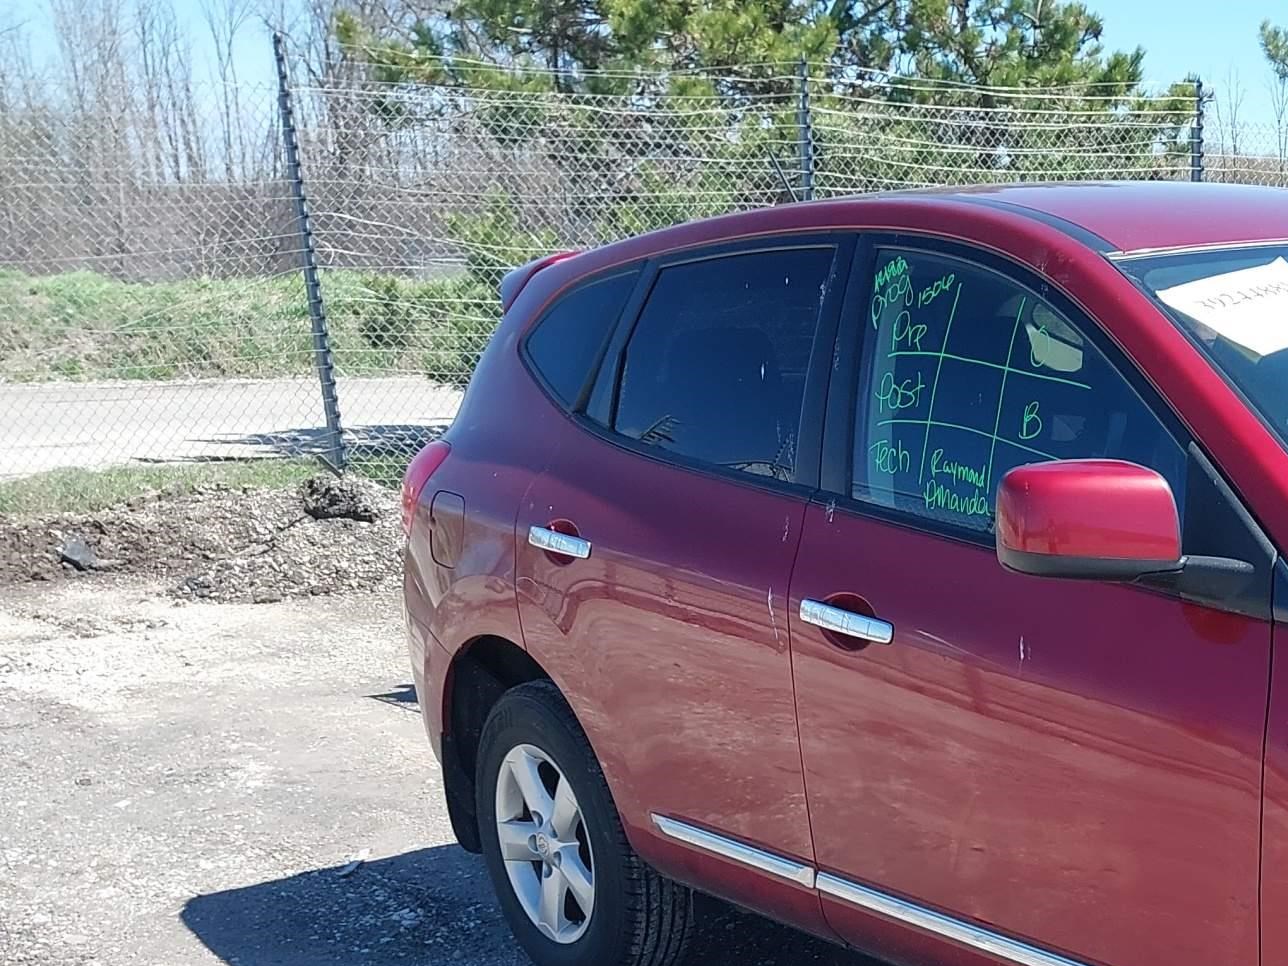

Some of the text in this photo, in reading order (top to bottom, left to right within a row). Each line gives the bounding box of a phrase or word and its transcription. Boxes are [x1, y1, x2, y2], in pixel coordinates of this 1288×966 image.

[875, 372, 926, 414] Post
[1018, 401, 1043, 440] B
[868, 439, 911, 474] Tech
[930, 448, 986, 488] Raymond
